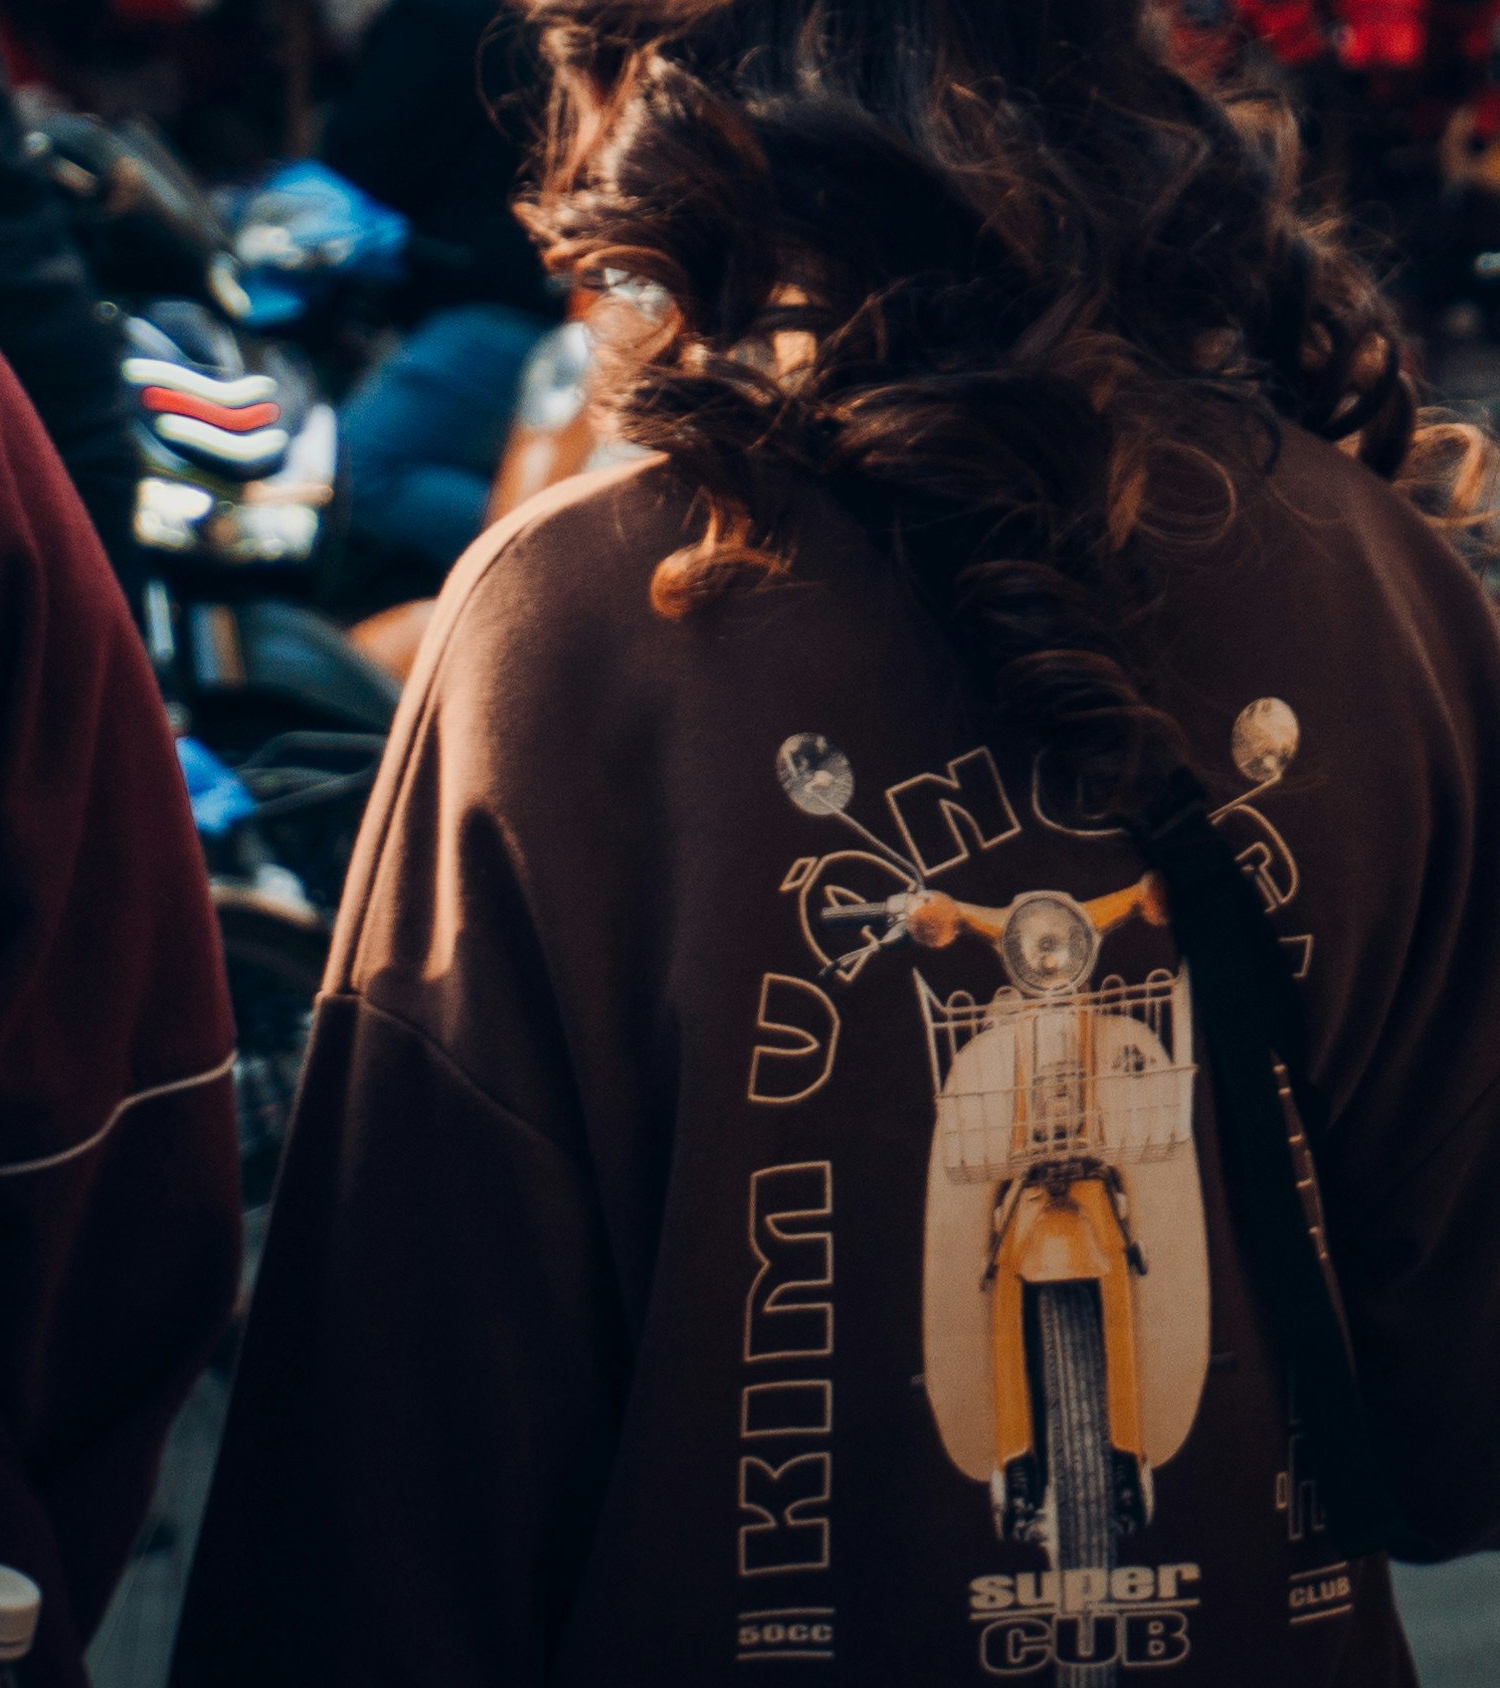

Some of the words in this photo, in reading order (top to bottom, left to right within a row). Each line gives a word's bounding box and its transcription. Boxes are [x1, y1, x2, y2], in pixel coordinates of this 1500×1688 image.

[736, 1159, 834, 1576] KIM
[967, 1561, 1201, 1613] super
[1288, 1575, 1351, 1609] CLUB
[978, 1610, 1192, 1677] CUB
